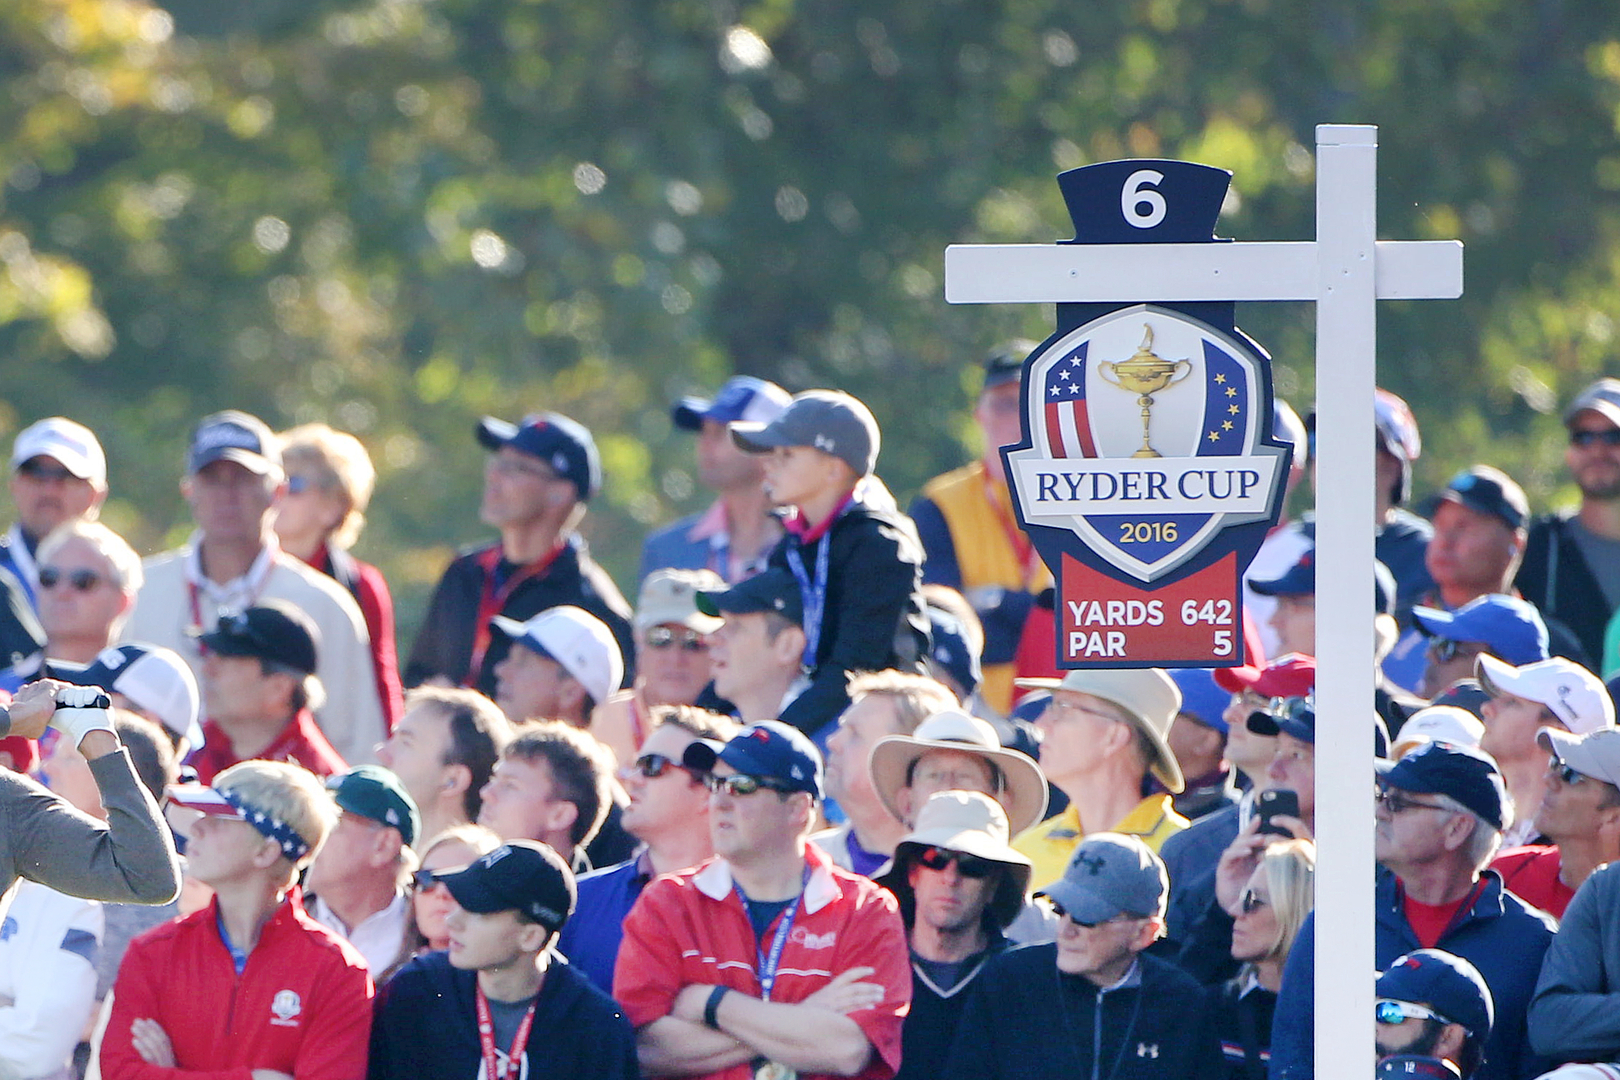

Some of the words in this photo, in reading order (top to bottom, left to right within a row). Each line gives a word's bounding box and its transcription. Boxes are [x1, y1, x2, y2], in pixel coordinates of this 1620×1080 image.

[1120, 170, 1167, 228] 6
[1036, 471, 1172, 502] RYDER
[1178, 469, 1260, 499] CUP
[1119, 522, 1178, 543] 2016
[1068, 600, 1164, 627] YARDS
[1180, 599, 1233, 625] 642
[1068, 630, 1126, 657] PAR
[1213, 629, 1232, 656] 5
